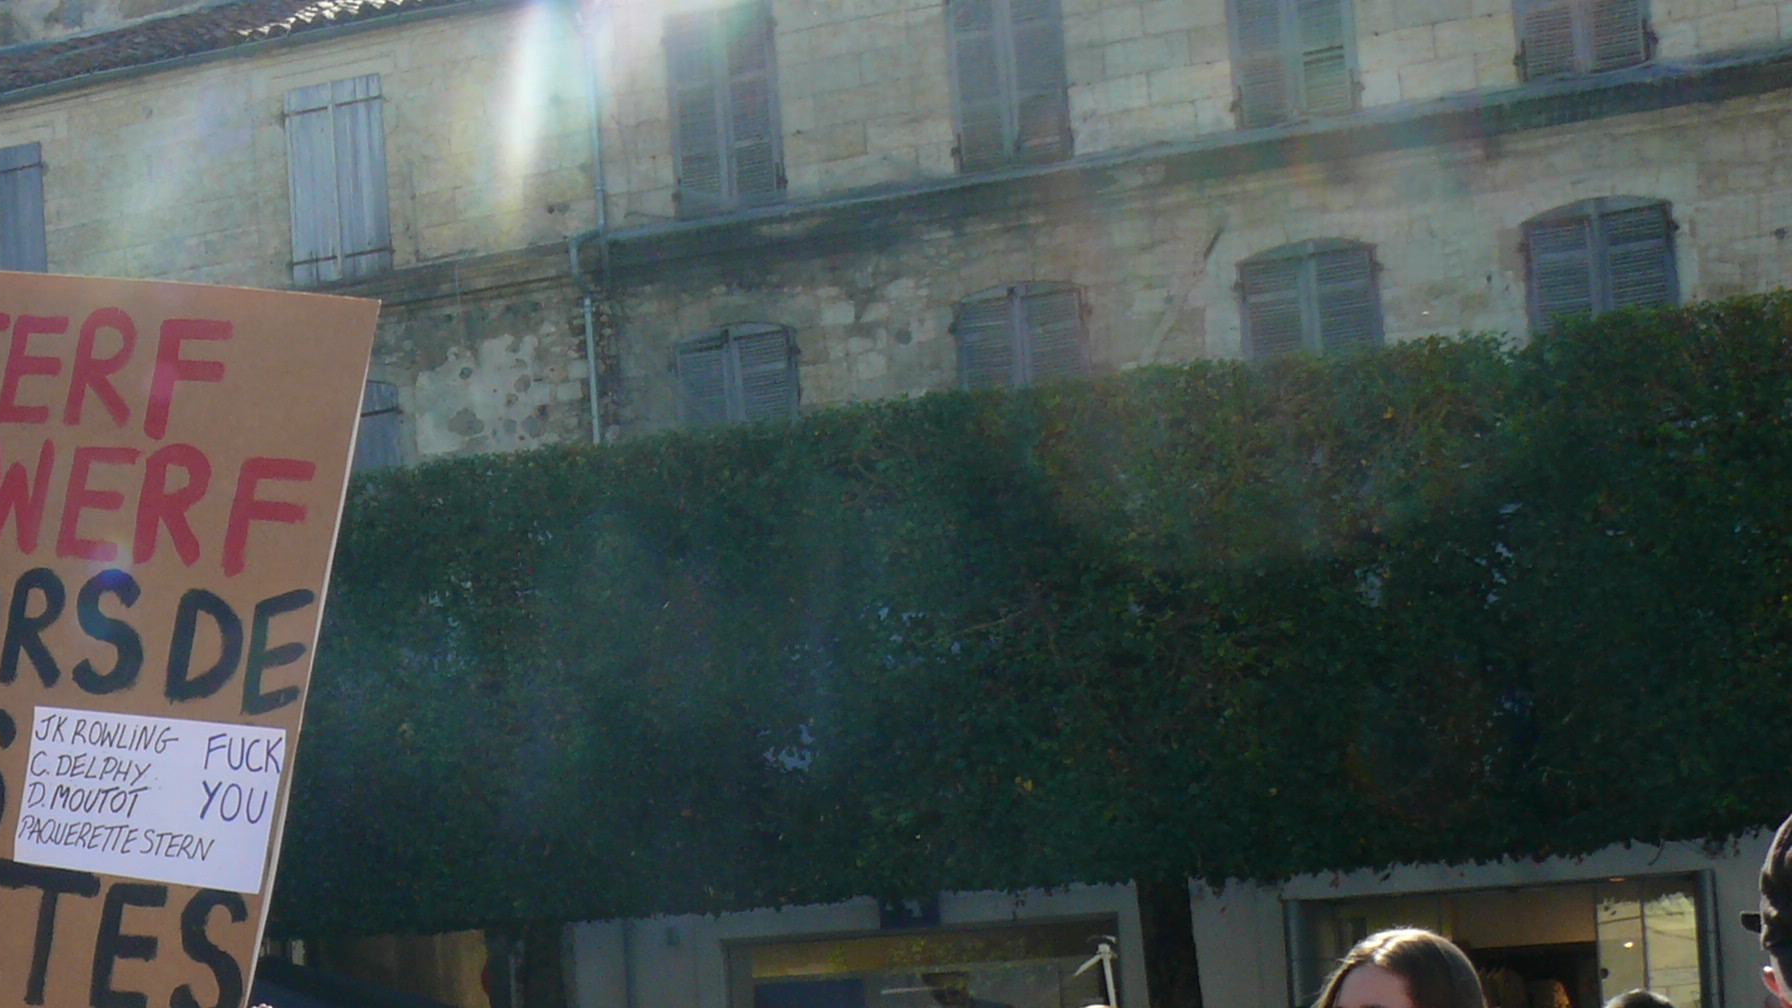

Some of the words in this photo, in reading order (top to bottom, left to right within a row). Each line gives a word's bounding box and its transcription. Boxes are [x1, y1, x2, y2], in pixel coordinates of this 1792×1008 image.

[165, 588, 315, 716] DE
[35, 714, 68, 742] JK
[30, 751, 50, 777] C.
[56, 753, 152, 787] DELPHY
[203, 733, 283, 774] FUCK
[28, 781, 46, 809] D.
[50, 783, 150, 818] MOUTOT
[200, 779, 268, 824] YOU
[18, 814, 139, 854] PAQUERETTE
[139, 829, 215, 862] STERN
